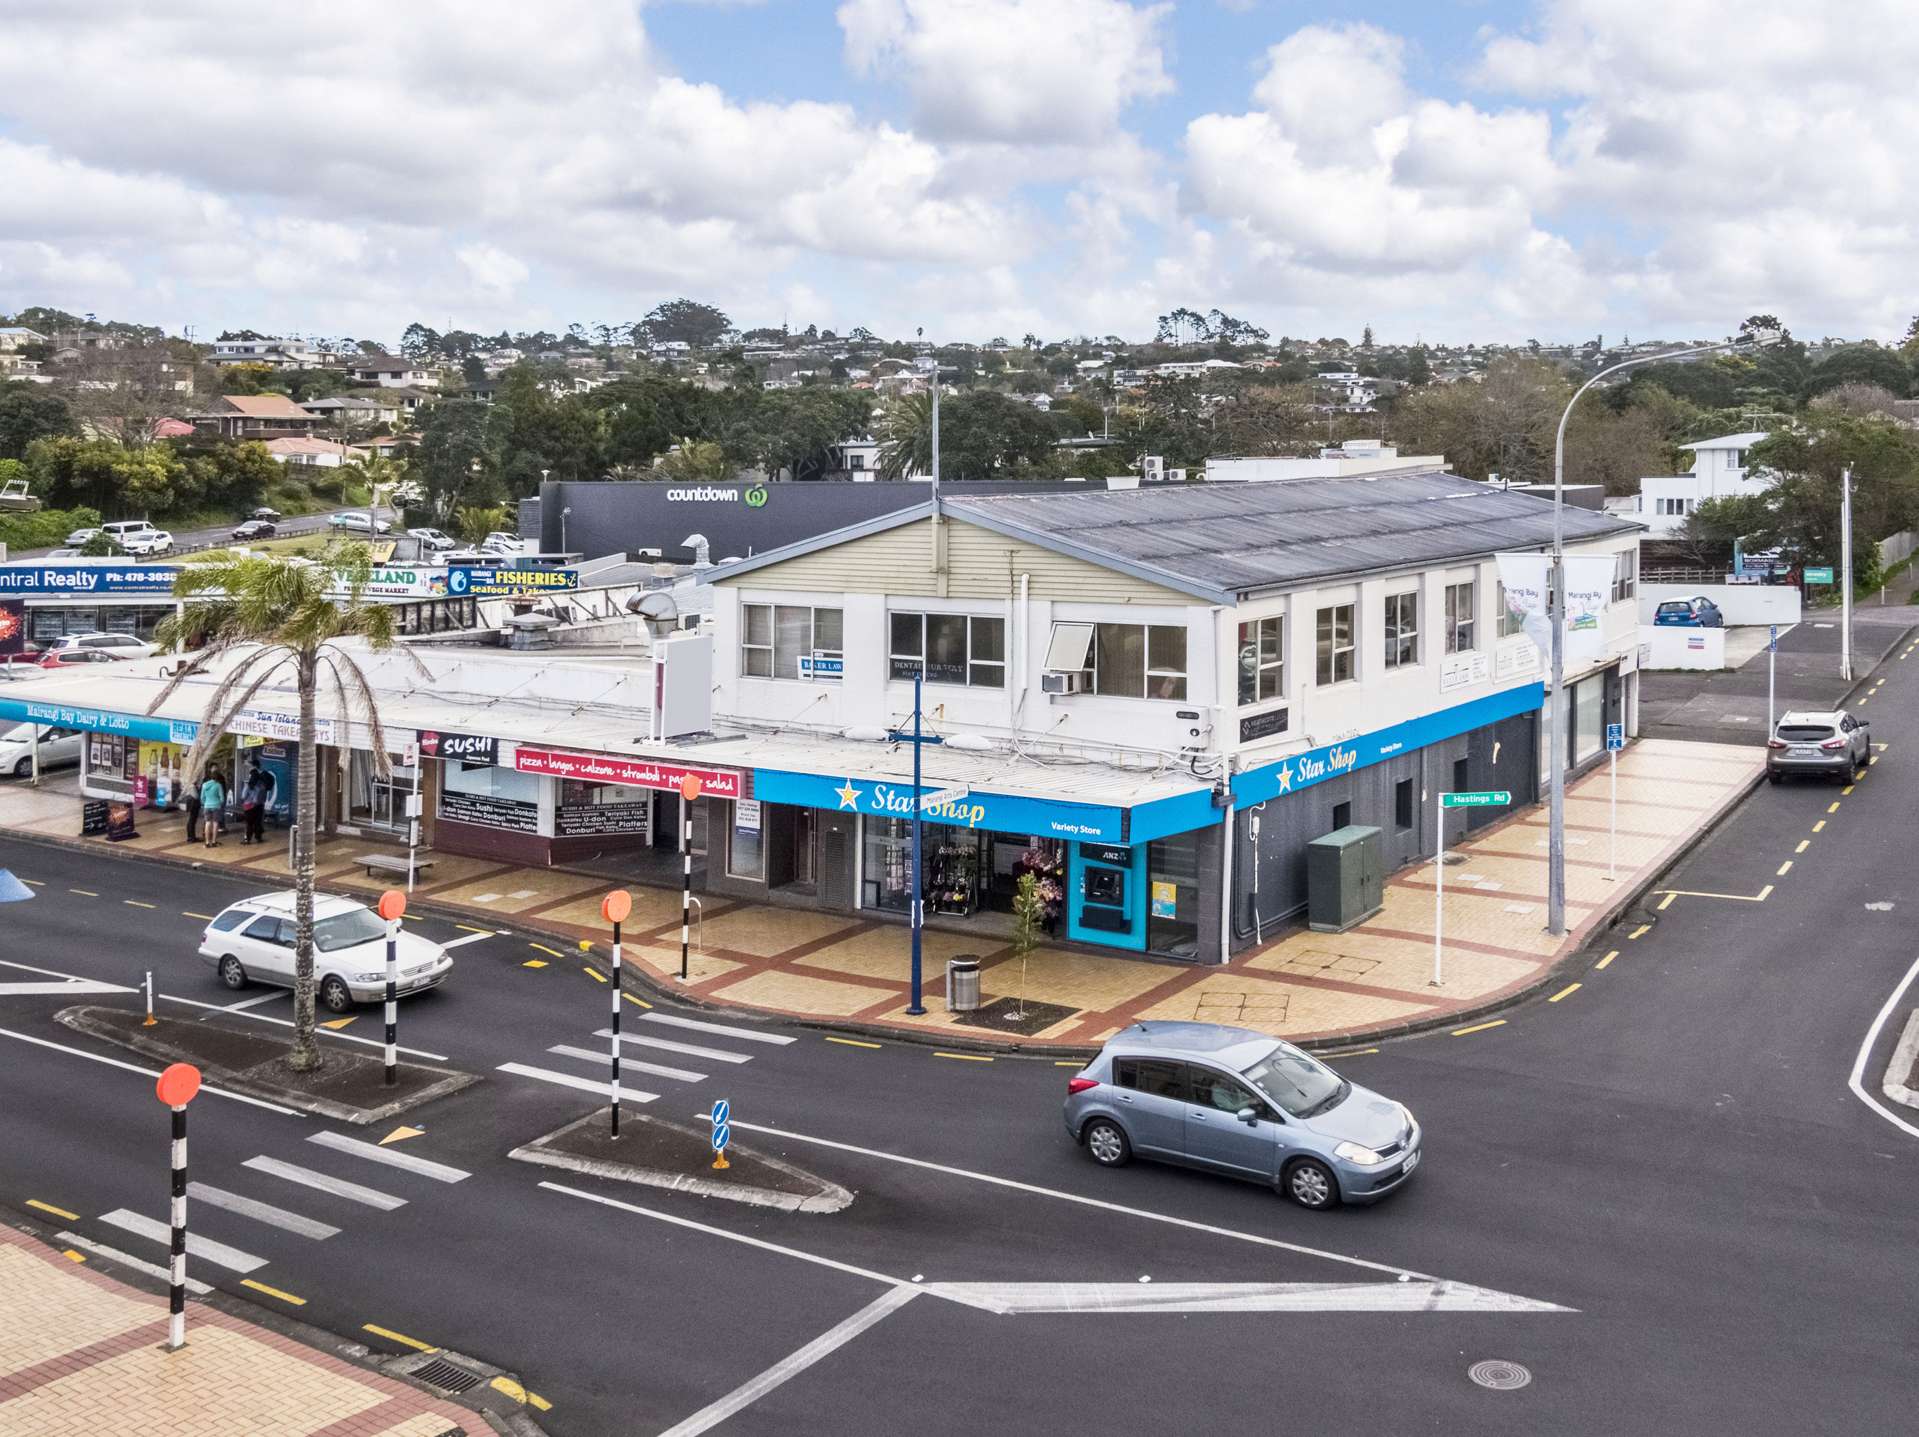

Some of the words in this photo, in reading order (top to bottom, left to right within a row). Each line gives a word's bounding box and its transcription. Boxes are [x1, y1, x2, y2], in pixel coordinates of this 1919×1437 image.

[667, 486, 738, 501] countdown
[44, 570, 98, 590] Realty
[106, 572, 123, 582] Ph:
[495, 570, 566, 586] FISHERIES
[385, 586, 409, 594] MARKET
[470, 585, 509, 594] Seafood
[61, 710, 75, 724] Bay
[77, 713, 98, 729] Dairy
[108, 716, 130, 730] Lotto
[256, 711, 272, 722] Sun
[231, 720, 268, 734] CHINESE
[444, 737, 492, 754] SUSHI
[1297, 757, 1325, 782] Star
[1327, 746, 1357, 772] Shop
[519, 754, 543, 769] pizza
[548, 753, 575, 774] langos
[581, 758, 615, 776] calzone
[706, 774, 734, 791] salad
[1454, 794, 1490, 803] Hastings
[1494, 794, 1505, 802] Rd
[476, 803, 493, 813] Sushi
[483, 812, 506, 821] Donburi
[619, 820, 648, 828] Platters
[1051, 821, 1079, 834] Variety
[1080, 825, 1101, 835] Store
[1103, 851, 1119, 860] ANZ
